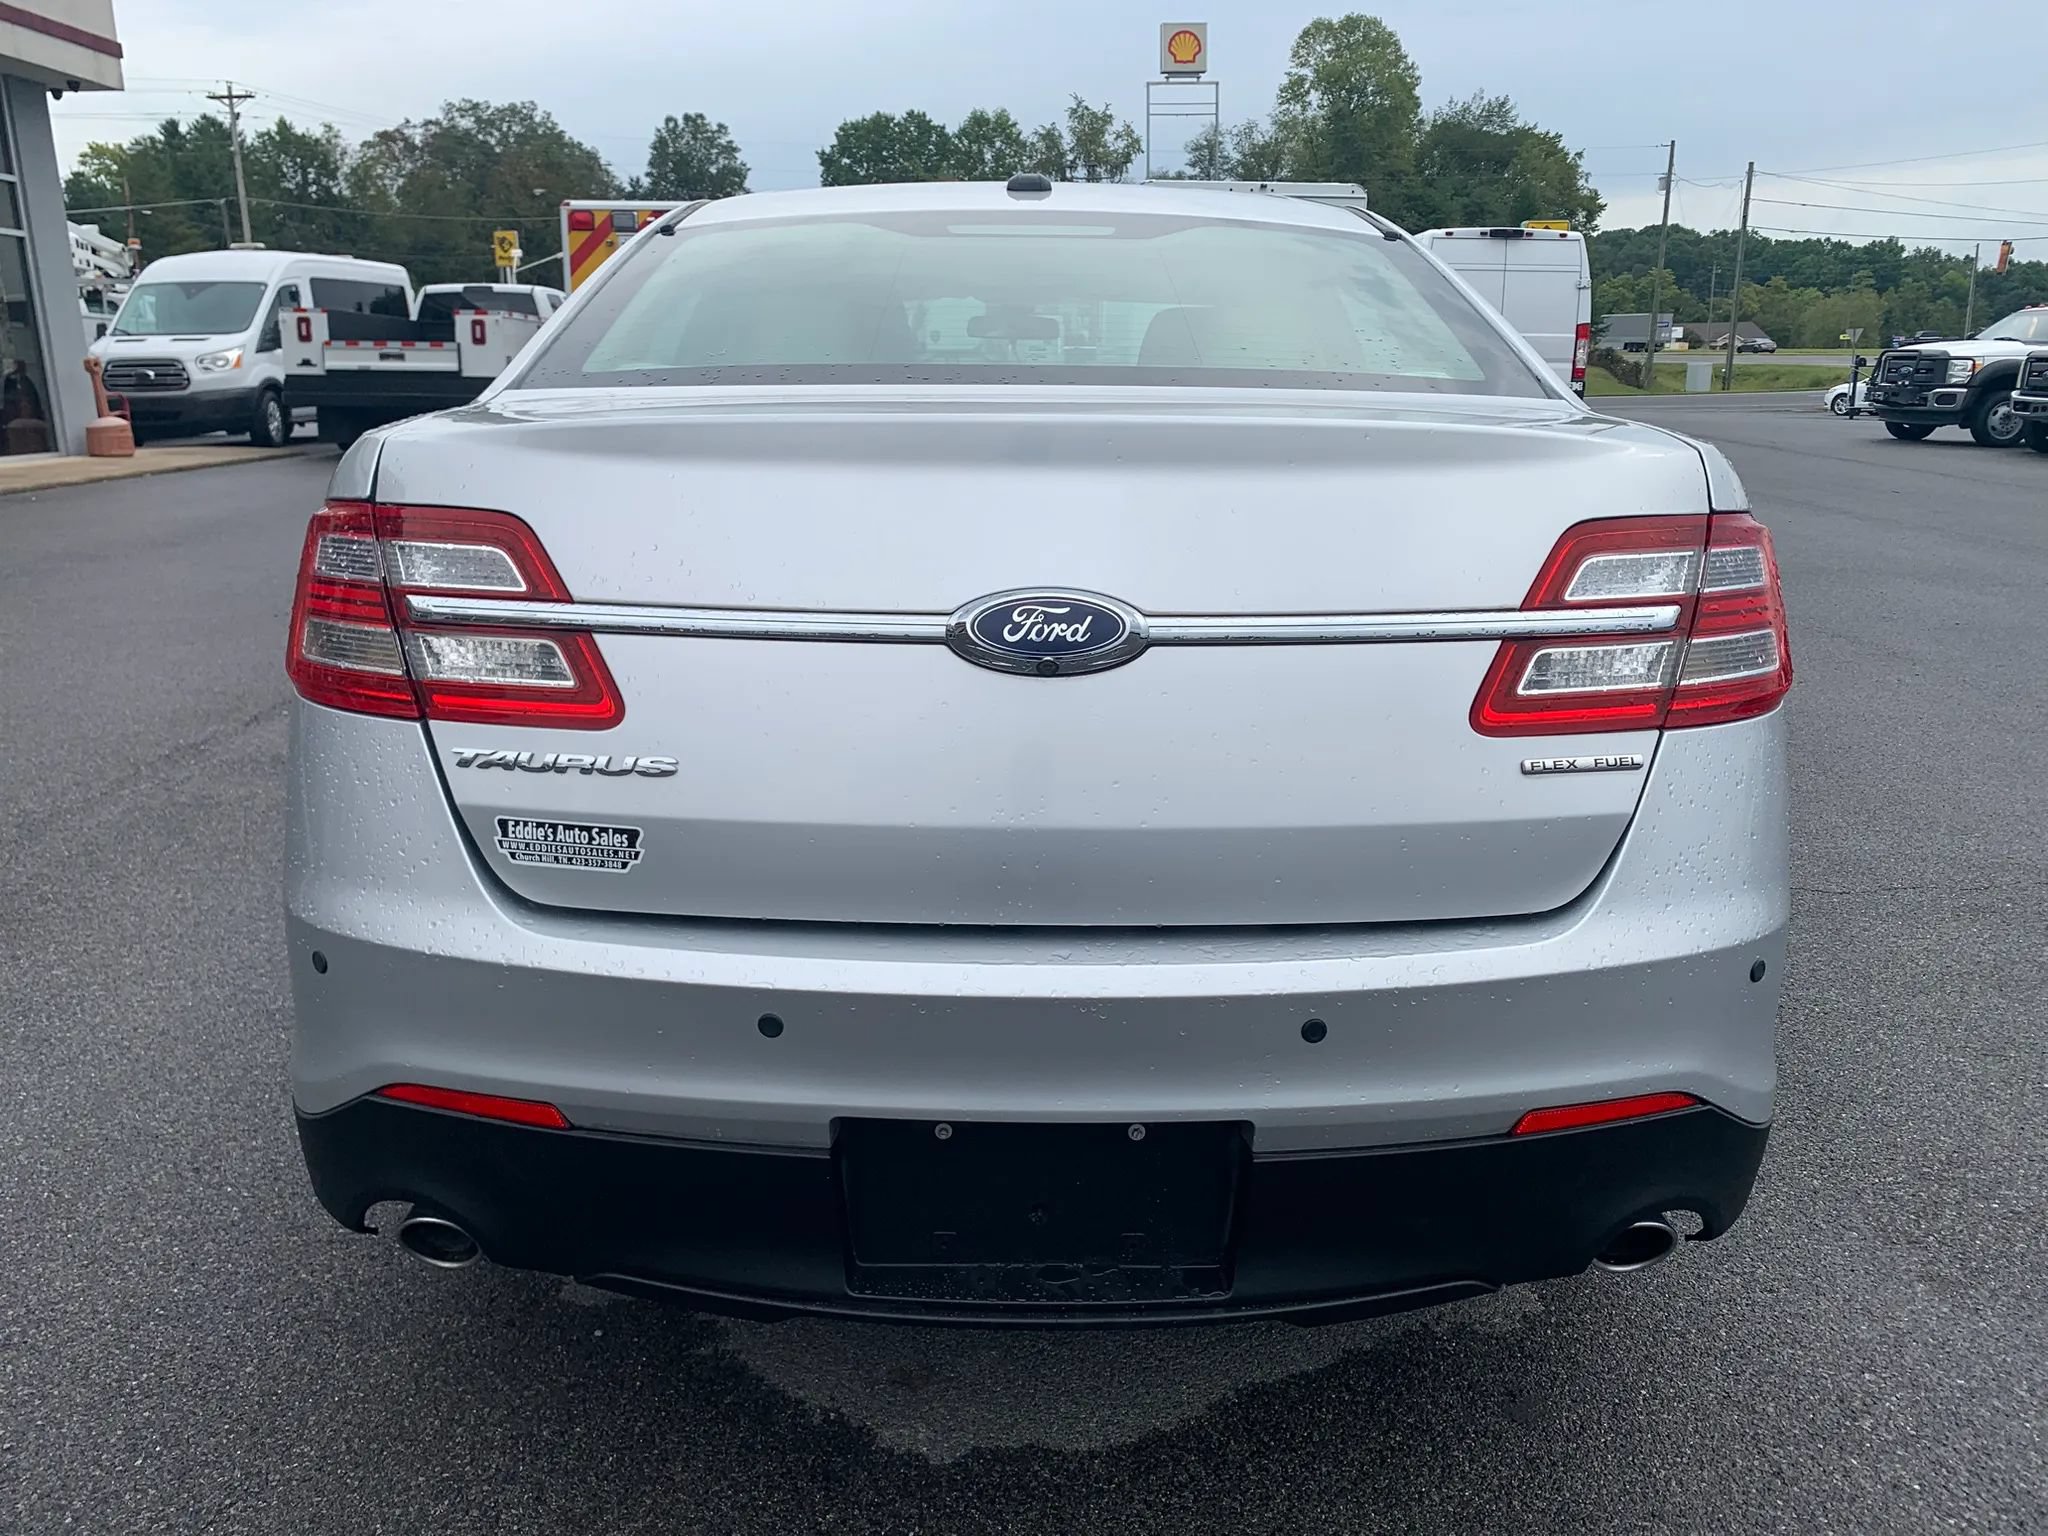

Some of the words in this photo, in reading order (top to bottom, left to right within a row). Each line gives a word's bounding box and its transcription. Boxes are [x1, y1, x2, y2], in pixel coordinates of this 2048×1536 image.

[1002, 605, 1093, 643] Ford
[451, 747, 679, 778] TAURUS
[1530, 759, 1578, 771] FLEX
[1594, 756, 1641, 768] FUEL
[508, 820, 554, 841] Eddie's
[556, 825, 589, 844] Auto
[592, 827, 629, 847] Sales
[502, 840, 636, 859] WWW.EDDIESAUTOSALES.NET
[515, 852, 541, 862] Church
[541, 855, 557, 865] Hill,
[572, 857, 622, 869] 423-357-3848
